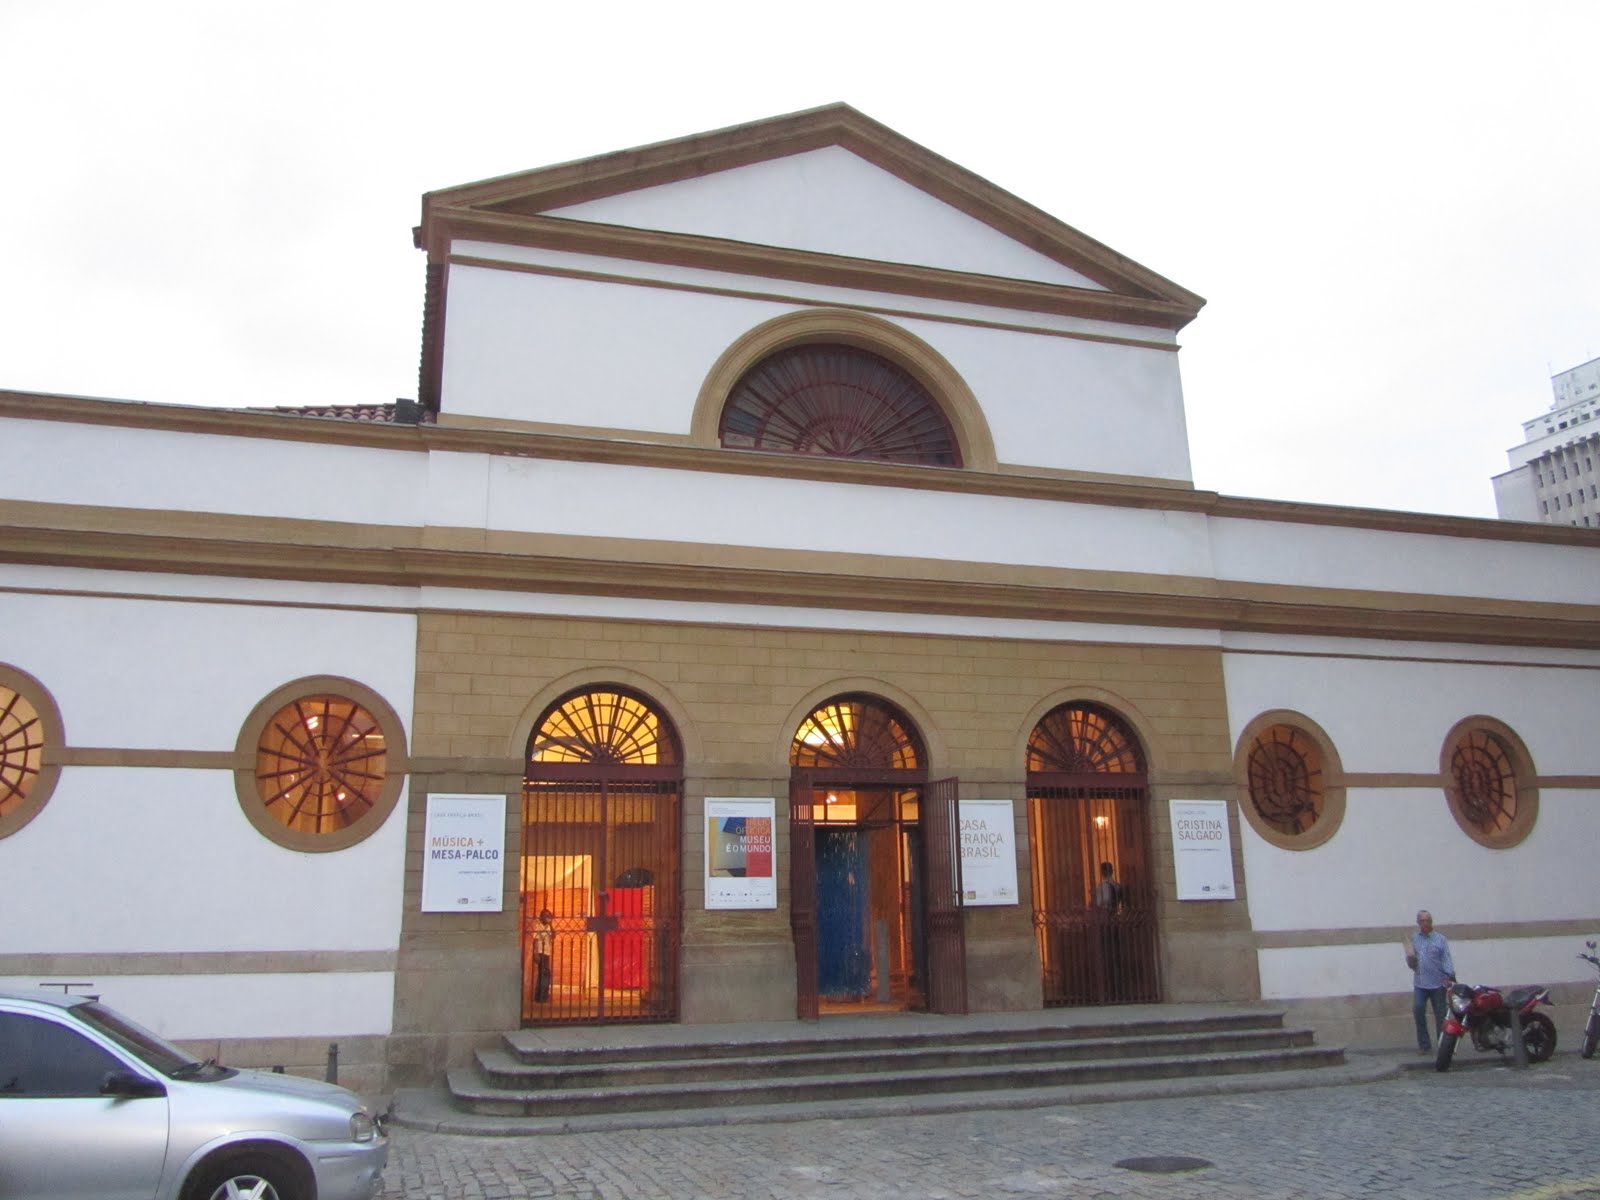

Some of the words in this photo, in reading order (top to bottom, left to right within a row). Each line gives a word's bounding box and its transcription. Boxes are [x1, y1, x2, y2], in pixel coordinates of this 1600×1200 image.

[959, 820, 987, 831] CASA
[1177, 820, 1222, 830] CRISTINA
[740, 835, 771, 843] MUSEU
[1178, 830, 1222, 840] SALGADO
[432, 835, 474, 847] MÚSICA
[431, 849, 499, 860] MESA-PALCO
[960, 846, 1001, 858] BRASIL
